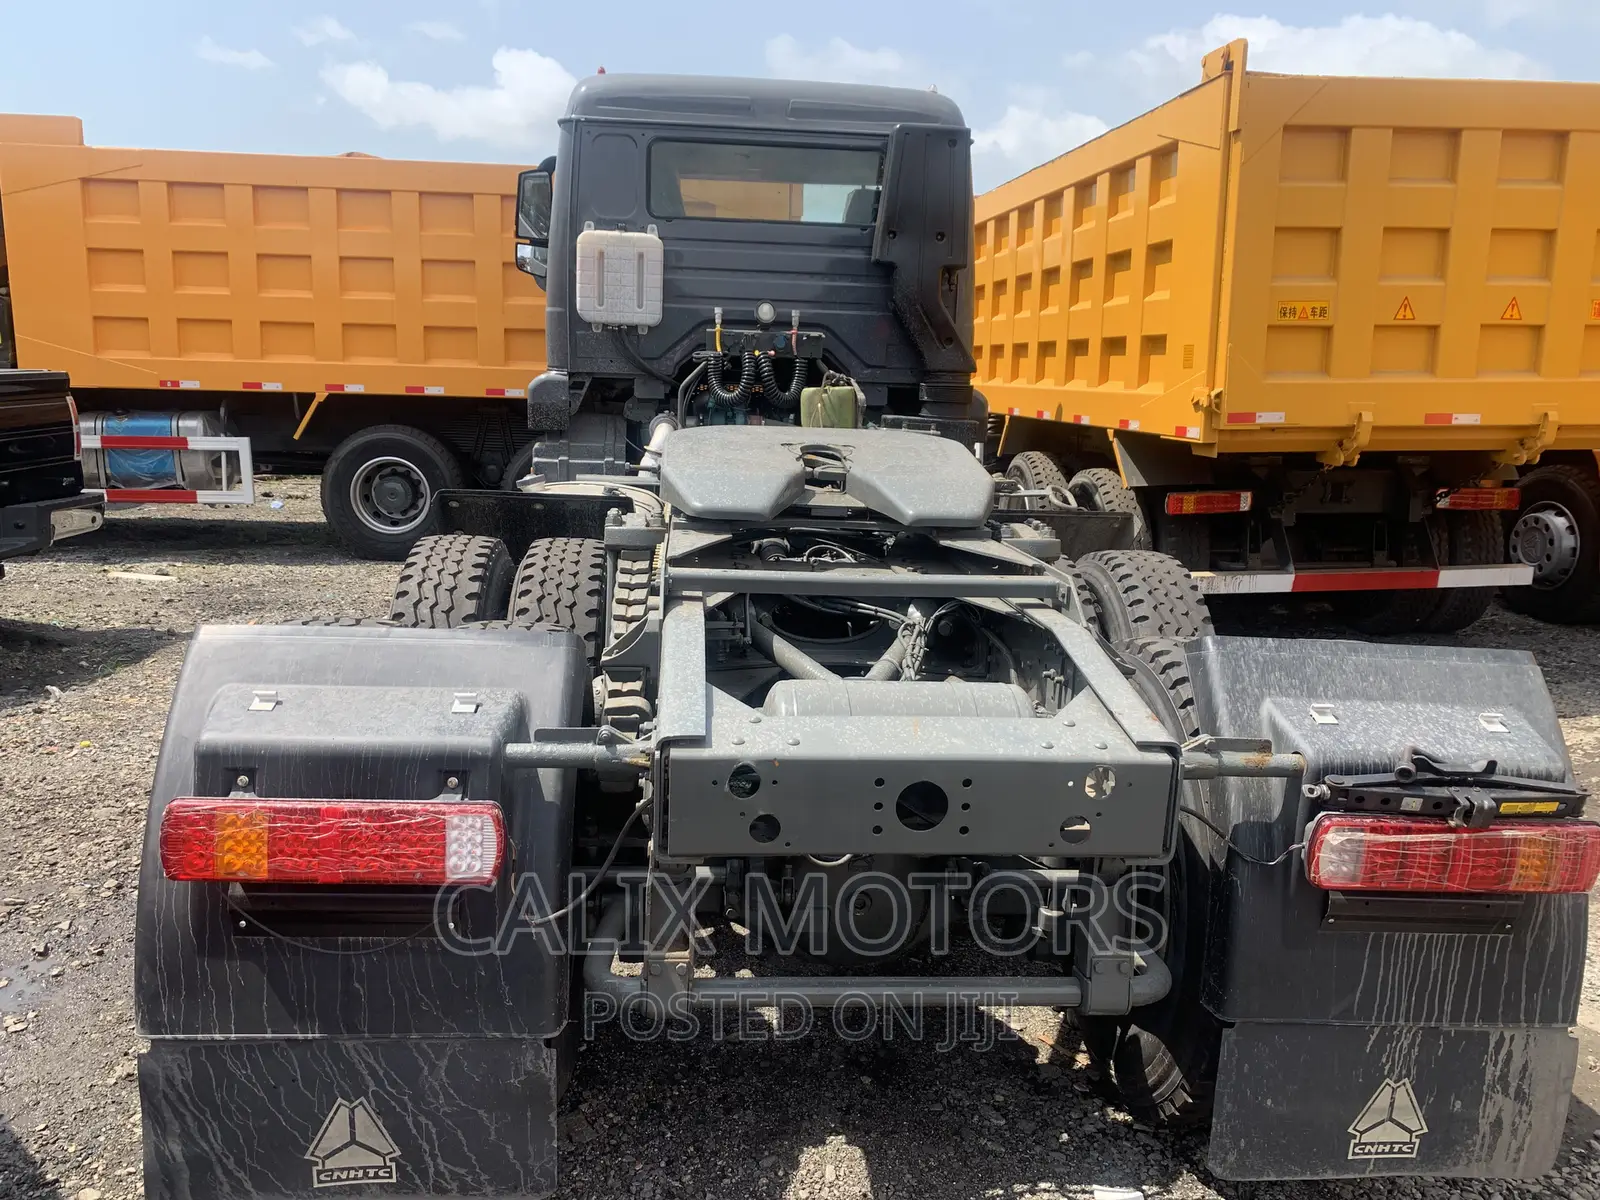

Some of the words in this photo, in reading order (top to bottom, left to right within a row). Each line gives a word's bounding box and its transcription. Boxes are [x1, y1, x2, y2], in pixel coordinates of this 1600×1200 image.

[1280, 306, 1297, 319] 保持
[1310, 306, 1328, 319] 车距
[1354, 1144, 1414, 1154] CNHTC
[319, 1168, 391, 1181] CNHTC
